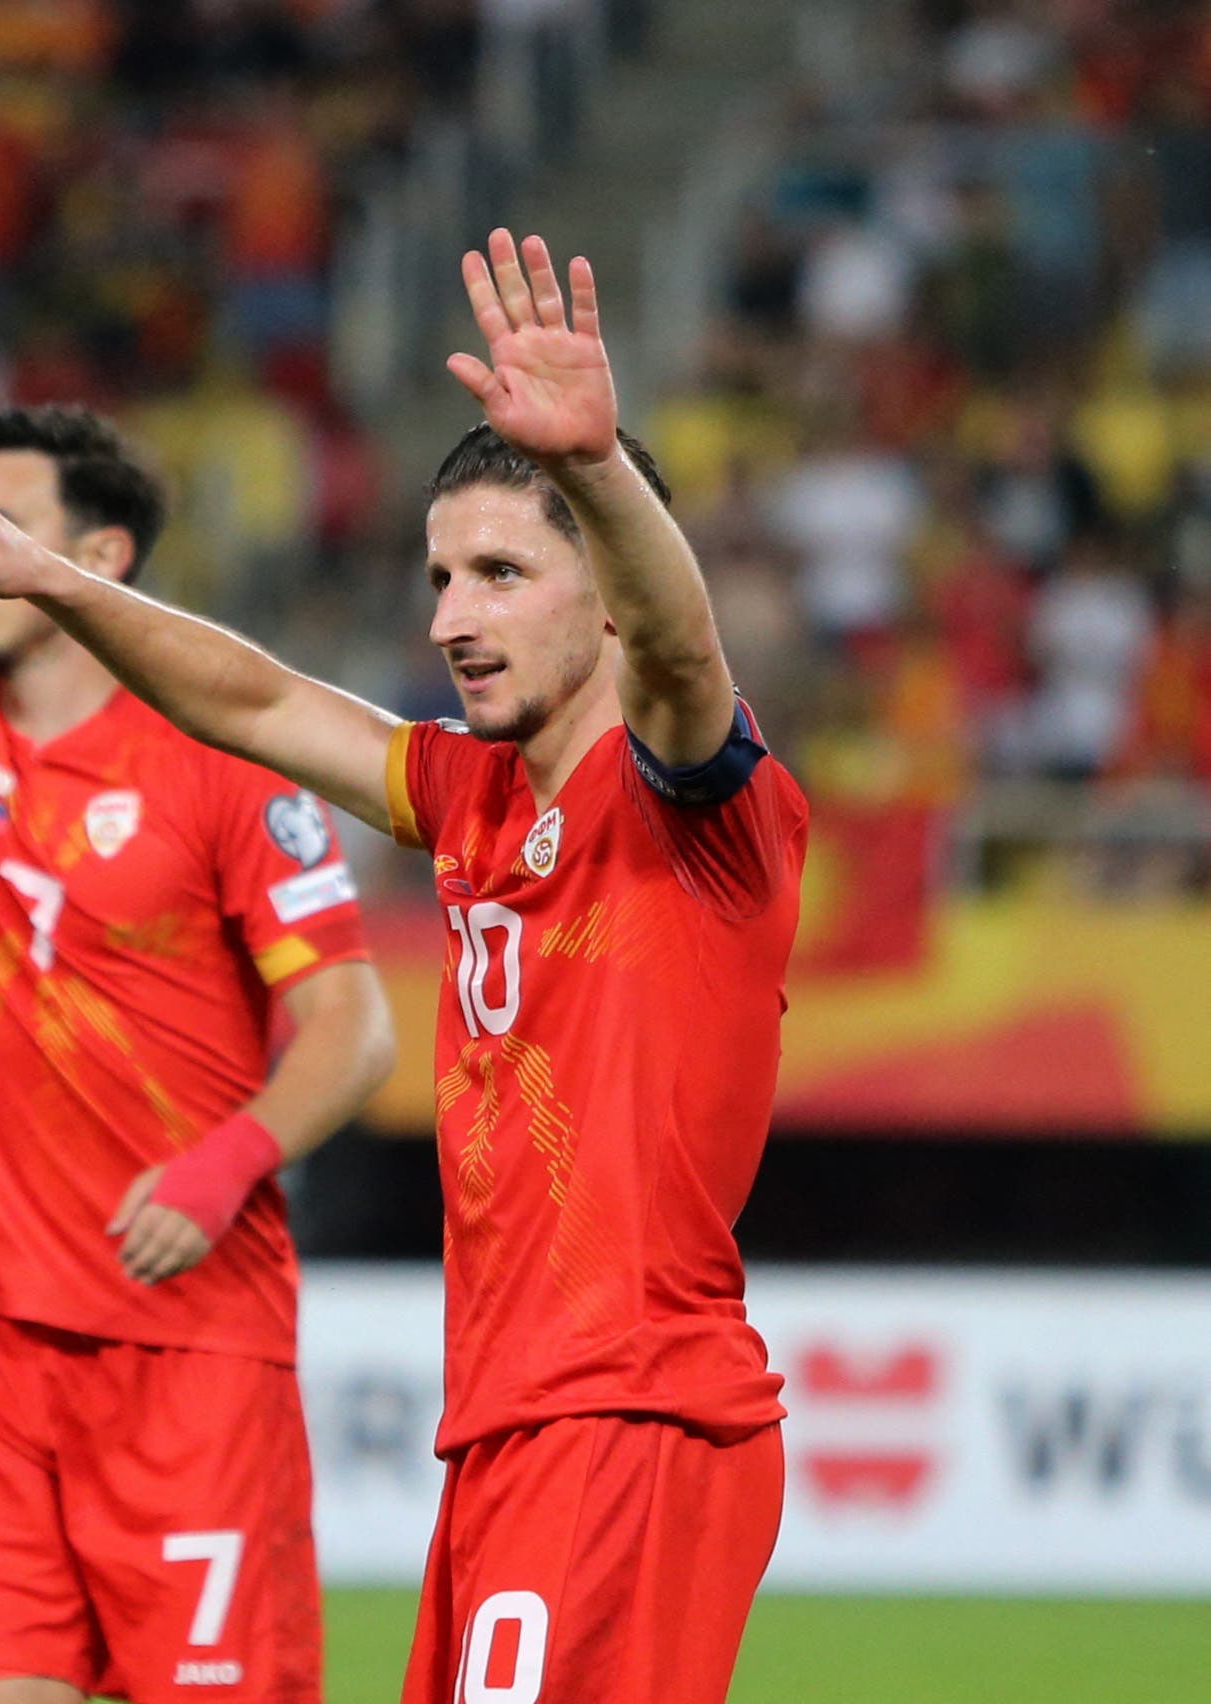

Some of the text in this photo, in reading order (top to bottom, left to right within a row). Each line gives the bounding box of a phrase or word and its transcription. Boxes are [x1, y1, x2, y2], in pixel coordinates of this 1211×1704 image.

[446, 901, 523, 1039] 10
[162, 1530, 245, 1647] 7
[173, 1660, 244, 1686] JAKO
